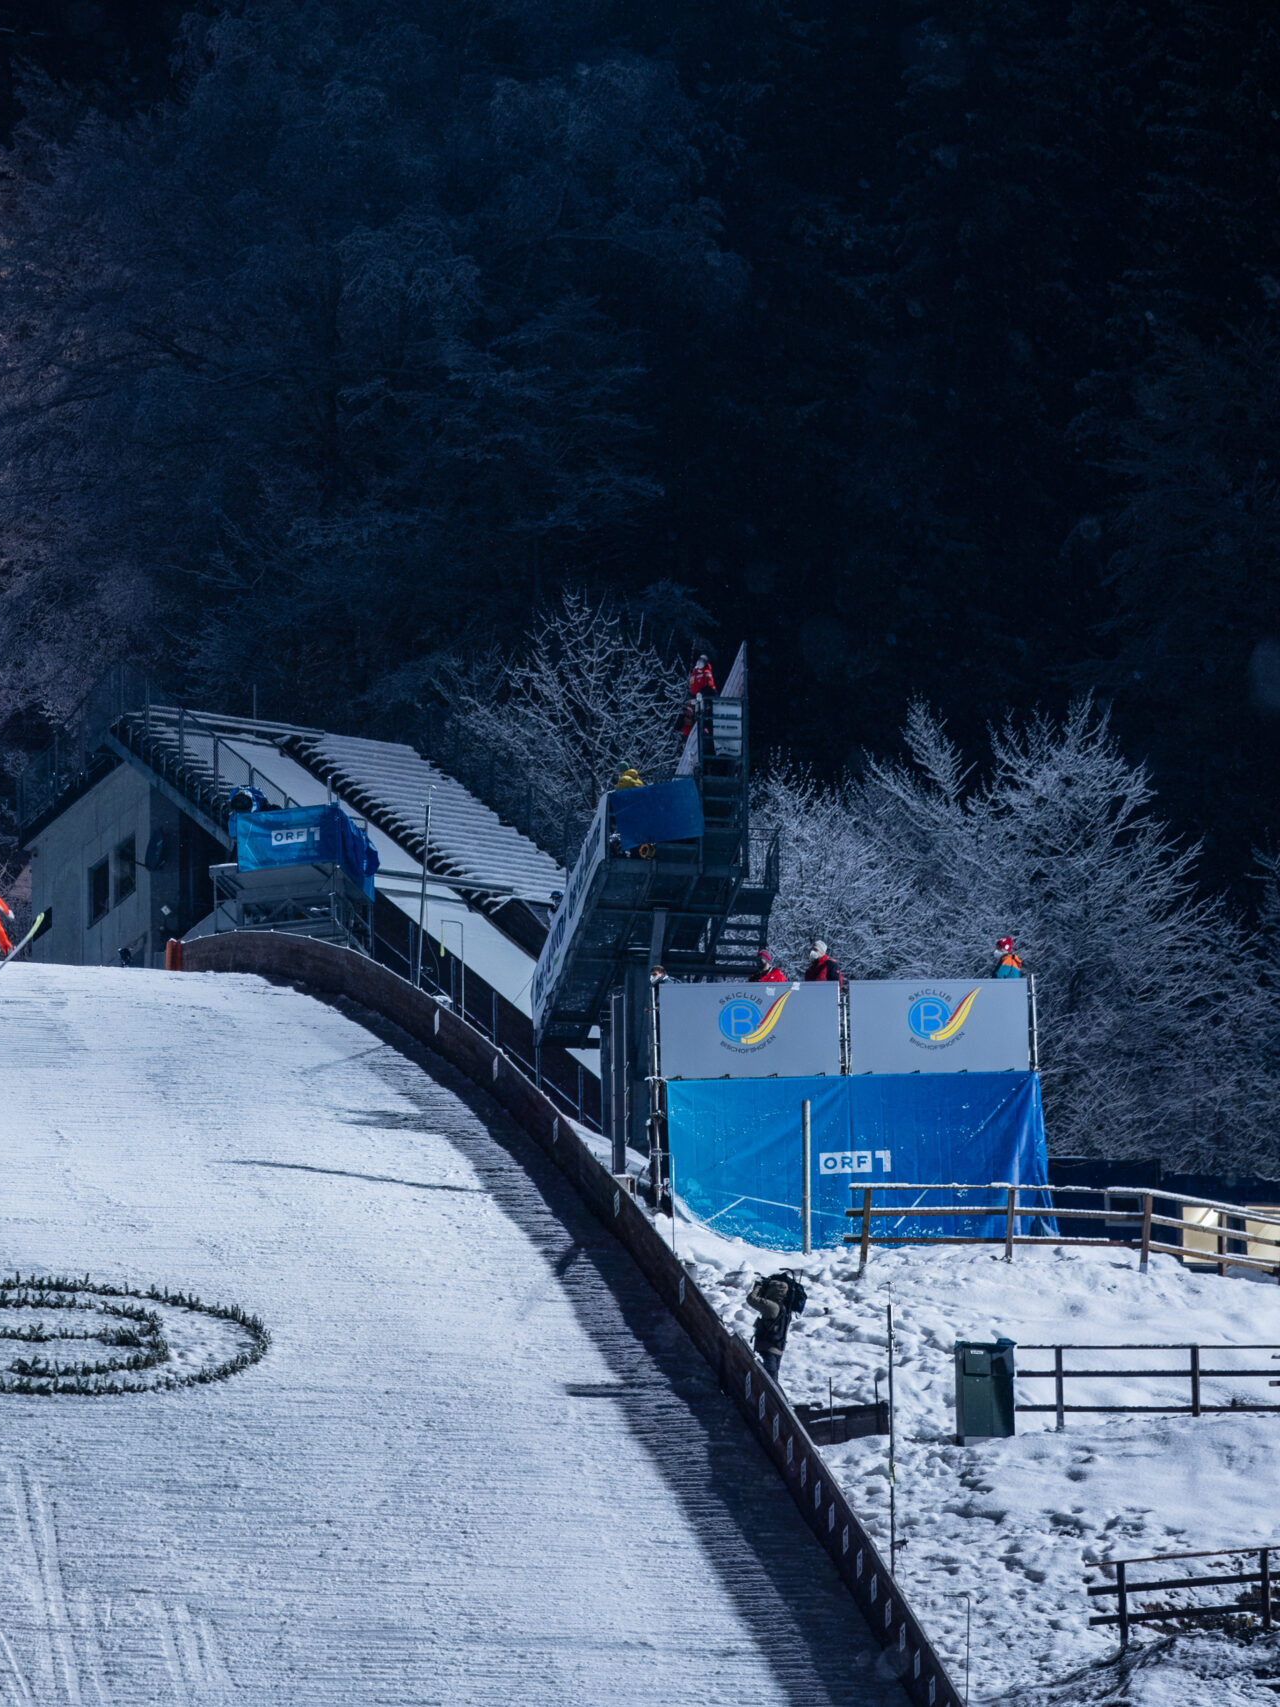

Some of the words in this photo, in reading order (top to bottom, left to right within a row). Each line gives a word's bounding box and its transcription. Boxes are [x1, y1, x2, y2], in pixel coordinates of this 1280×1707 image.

[274, 831, 304, 842] ORF
[718, 991, 763, 1006] SKICLUB
[908, 988, 952, 1003] SKICLUB
[731, 1005, 754, 1037] B
[920, 1002, 944, 1033] B
[720, 1034, 777, 1054] BISCHOFSHOFEN
[909, 1031, 966, 1051] BISCHOFSHOFEN
[823, 1155, 868, 1170] ORF
